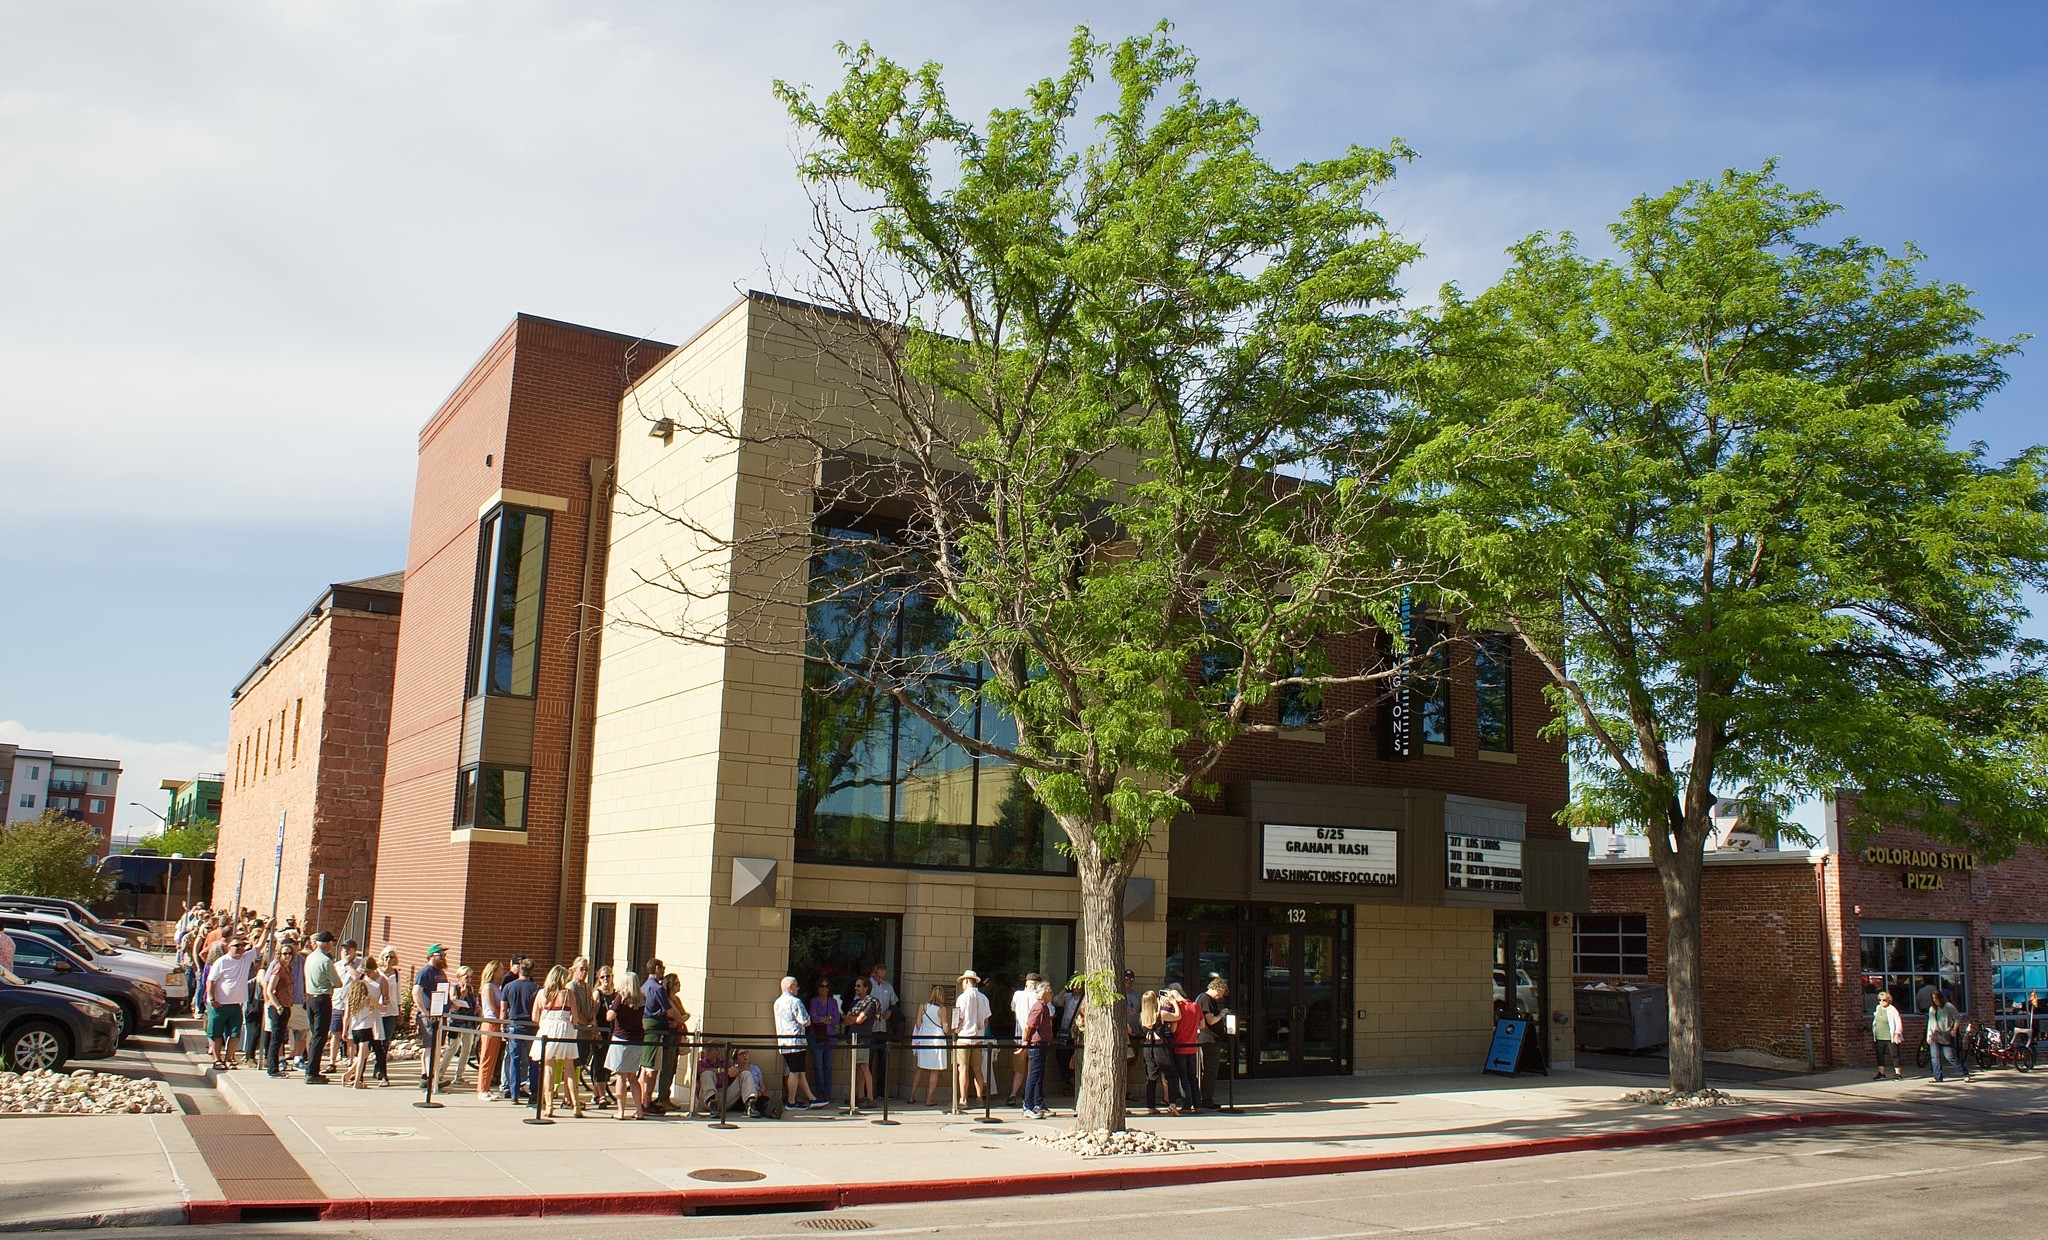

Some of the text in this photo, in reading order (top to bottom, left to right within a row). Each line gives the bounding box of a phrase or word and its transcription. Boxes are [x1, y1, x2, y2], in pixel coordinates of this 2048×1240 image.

[1316, 828, 1344, 840] 6/25
[1285, 841, 1369, 856] GRAHAM NASH
[1867, 847, 1979, 870] COLORADO STYLE
[1265, 868, 1396, 884] WASHINGTONSFOCO.COM
[1907, 873, 1944, 890] PIZZA
[1287, 908, 1306, 923] 132
